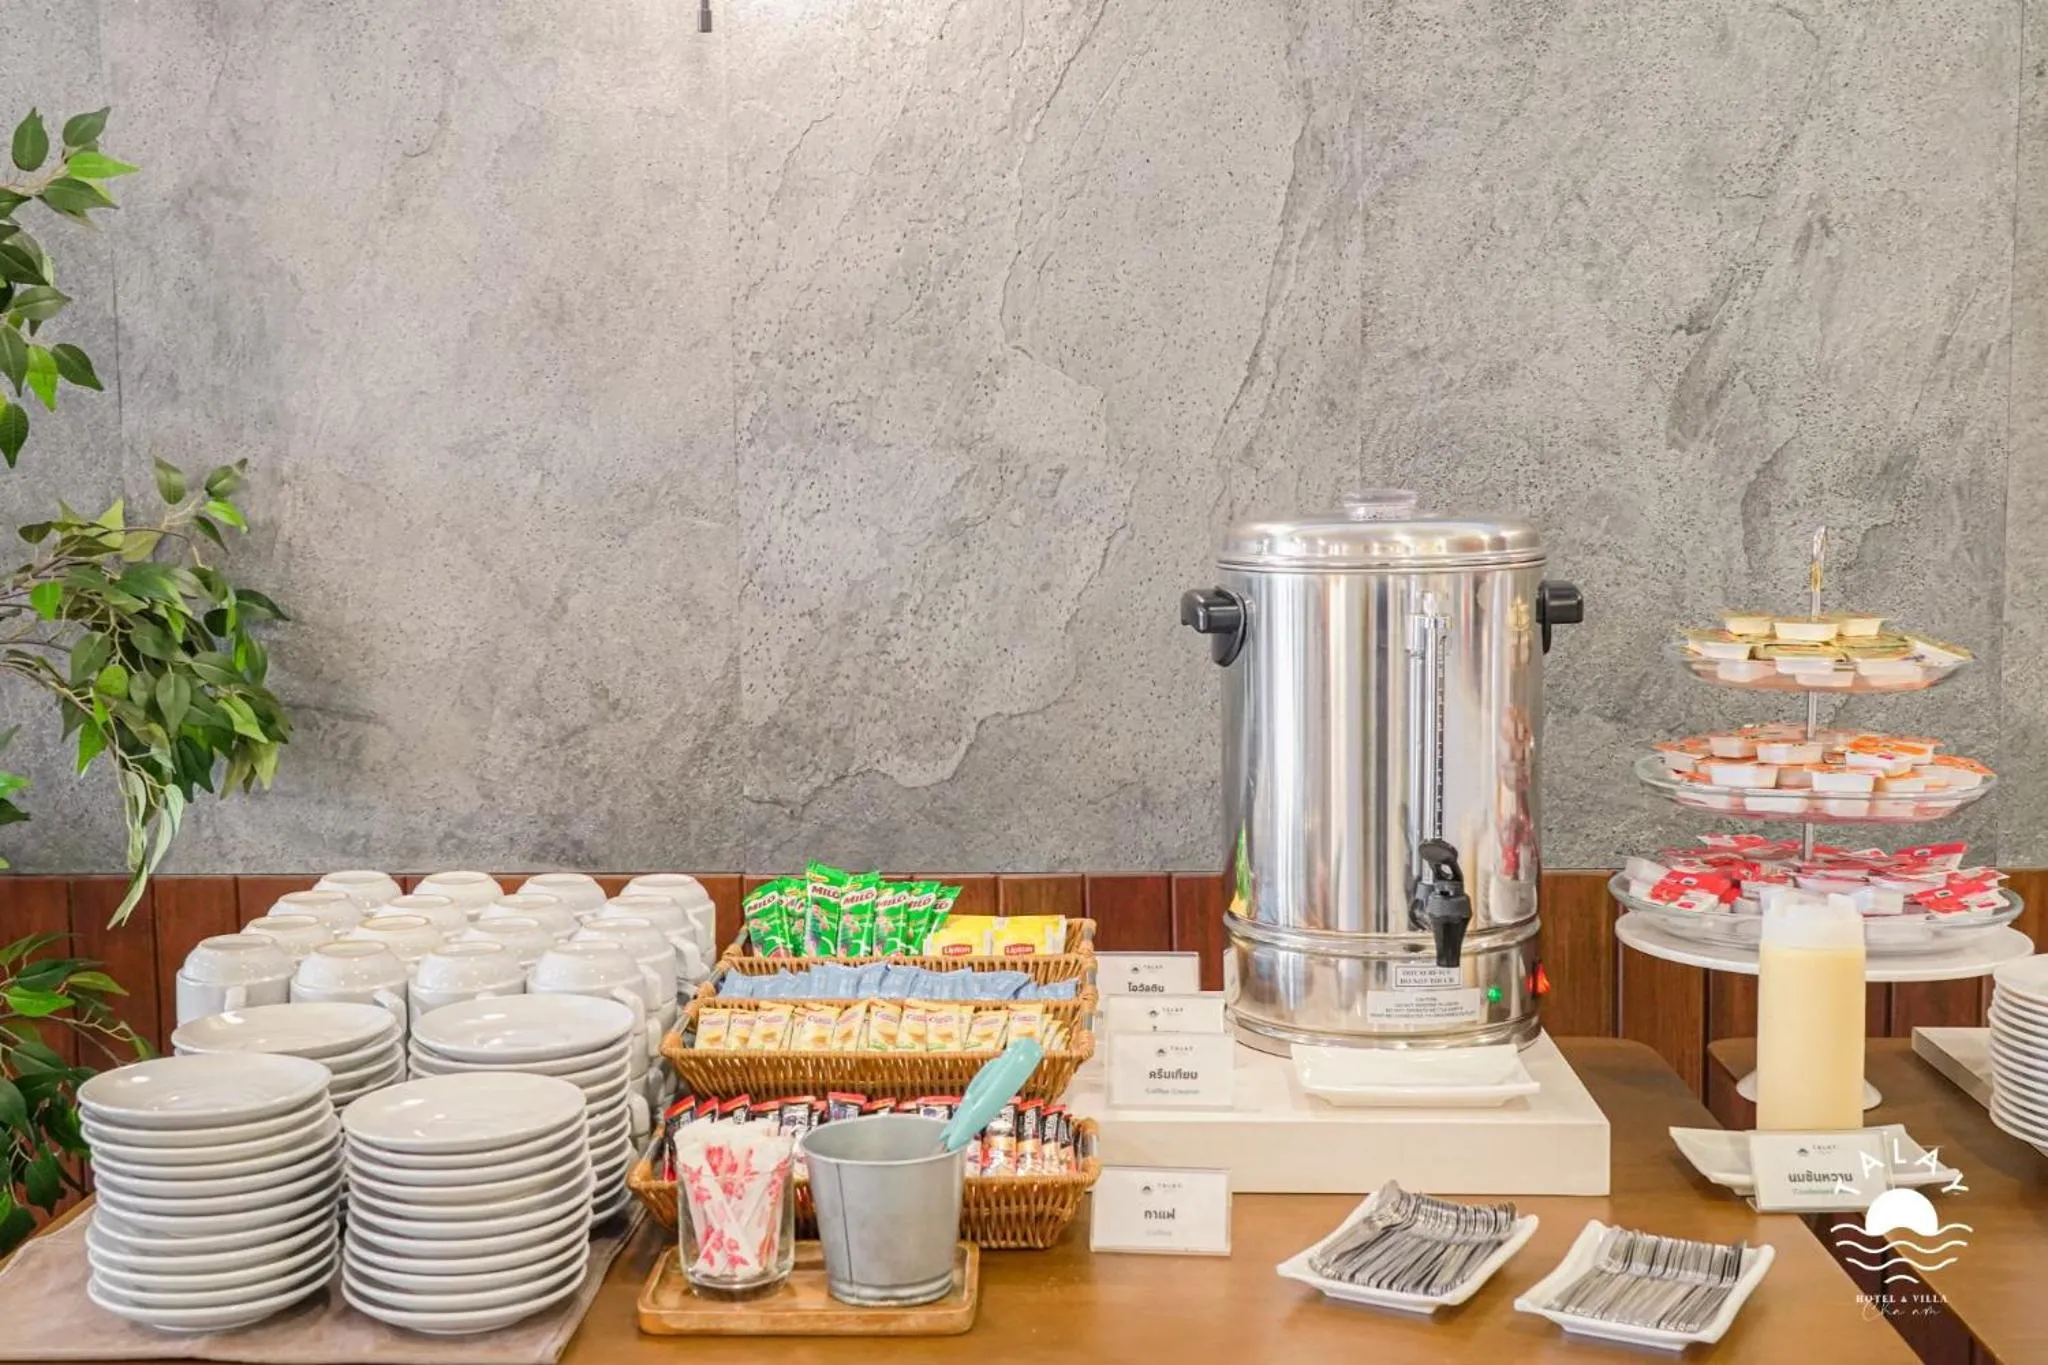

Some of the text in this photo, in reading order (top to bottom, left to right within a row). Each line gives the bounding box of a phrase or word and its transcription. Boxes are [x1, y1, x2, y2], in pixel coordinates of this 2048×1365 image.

[843, 890, 874, 907] MILO
[1127, 981, 1165, 993] โอวัลติน
[1148, 1067, 1199, 1081] ครีมเทียม
[1143, 1207, 1176, 1220] กาแฟ
